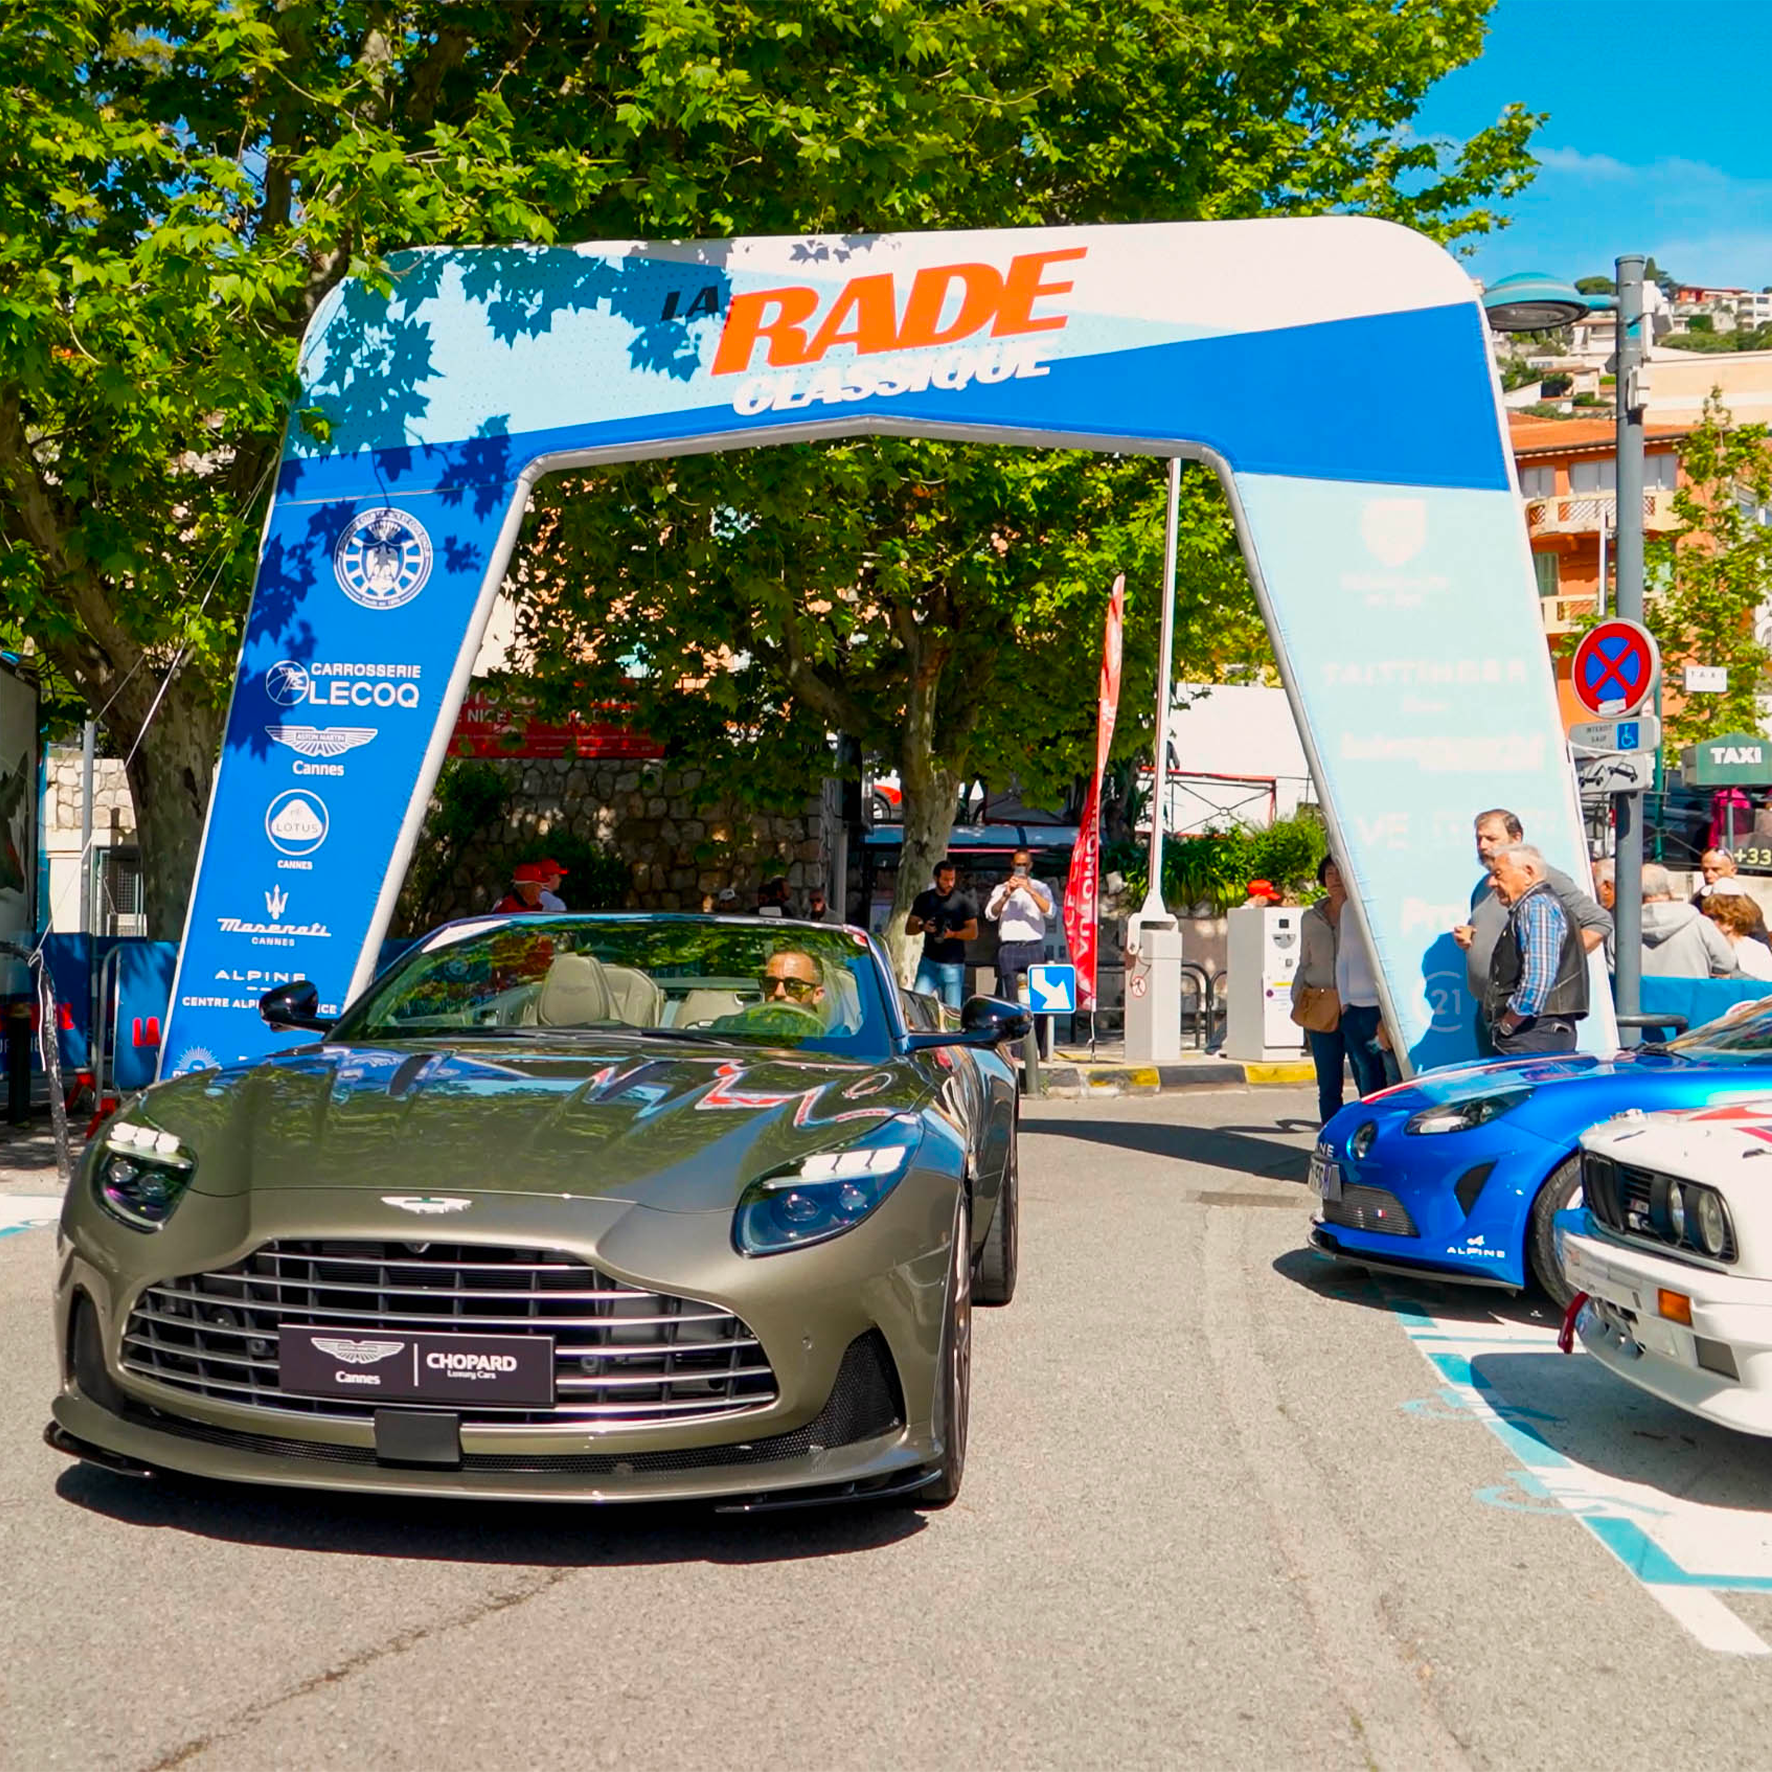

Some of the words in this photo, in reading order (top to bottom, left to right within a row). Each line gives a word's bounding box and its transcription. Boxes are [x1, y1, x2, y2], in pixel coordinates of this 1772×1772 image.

[661, 286, 719, 321] LA
[711, 247, 1088, 375] RADE
[733, 338, 1055, 416] CLASSIQUE
[311, 662, 421, 678] CARROSSERIE
[309, 680, 420, 708] LECOQ
[1710, 747, 1762, 764] TAXI
[292, 760, 345, 776] Cannes
[276, 822, 318, 834] LOTUS
[1734, 847, 1772, 865] +33
[277, 860, 313, 870] CANNES
[217, 918, 332, 937] Maserati
[251, 937, 295, 947] CANNES
[182, 996, 229, 1007] CENTRE
[1446, 1247, 1505, 1258] ALPINE
[427, 1353, 517, 1371] CHOPARD
[335, 1371, 381, 1385] Cannes
[447, 1369, 476, 1380] Luxury
[477, 1371, 496, 1379] Cars
